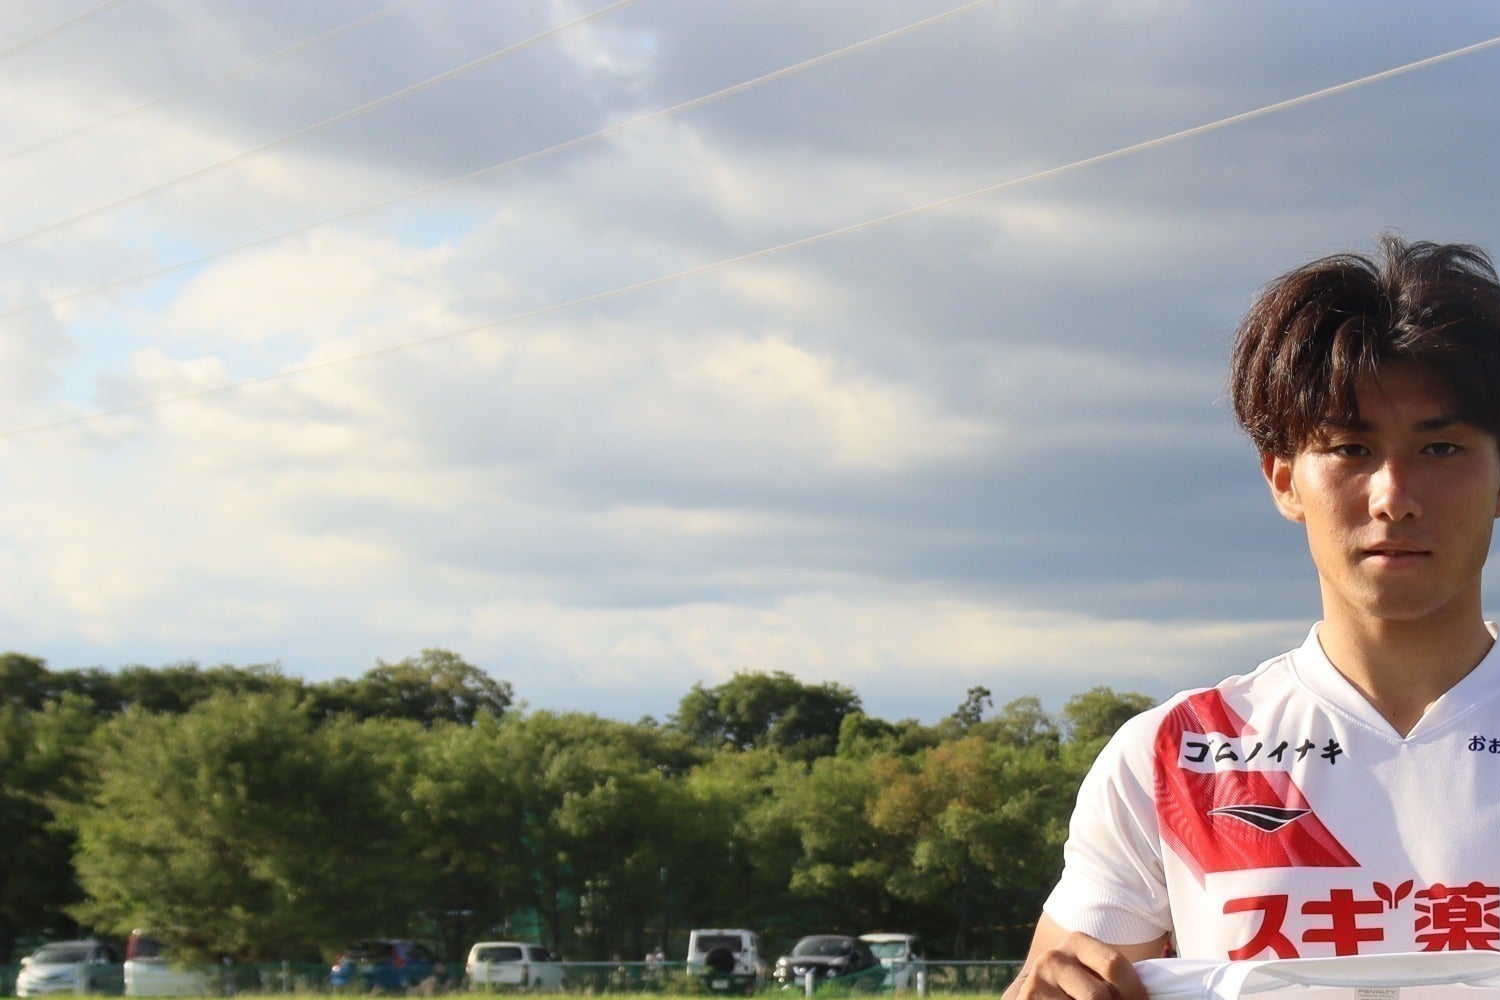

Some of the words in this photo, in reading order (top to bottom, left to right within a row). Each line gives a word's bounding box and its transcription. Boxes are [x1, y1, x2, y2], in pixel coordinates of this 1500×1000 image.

[1184, 738, 1343, 765] ゴムノイナキ
